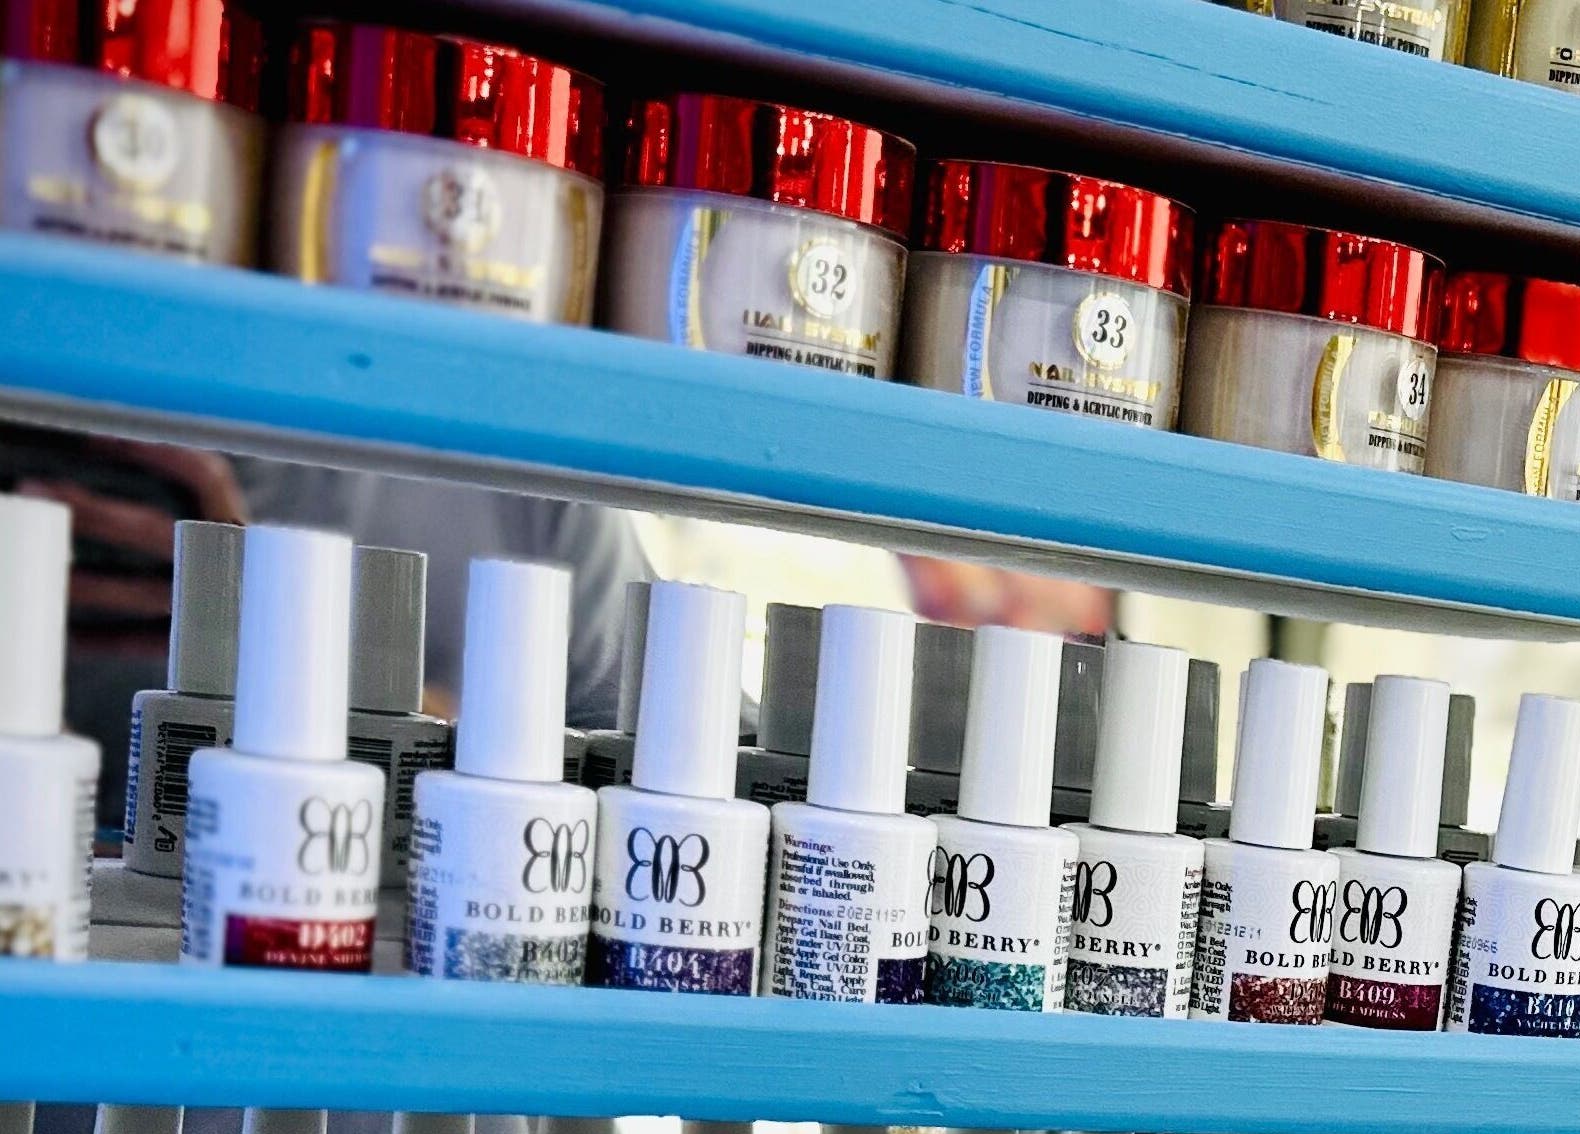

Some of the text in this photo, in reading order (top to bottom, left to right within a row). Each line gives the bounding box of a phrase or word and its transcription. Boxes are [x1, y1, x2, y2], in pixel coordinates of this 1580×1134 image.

[812, 259, 848, 300] 32
[968, 284, 993, 360] FORMULA
[1092, 309, 1128, 348] 33
[746, 341, 792, 362] DIPPING
[804, 352, 844, 372] ACRYLIC
[1408, 372, 1427, 406] 34
[1026, 390, 1070, 411] DIPPING
[1083, 401, 1120, 419] ACRYLIC
[829, 879, 874, 894] through
[466, 900, 544, 923] BOLD
[892, 931, 928, 949] BOL
[1245, 949, 1305, 969] BOLD
[1488, 962, 1548, 985] BOLD
[1339, 979, 1397, 1008] B409
